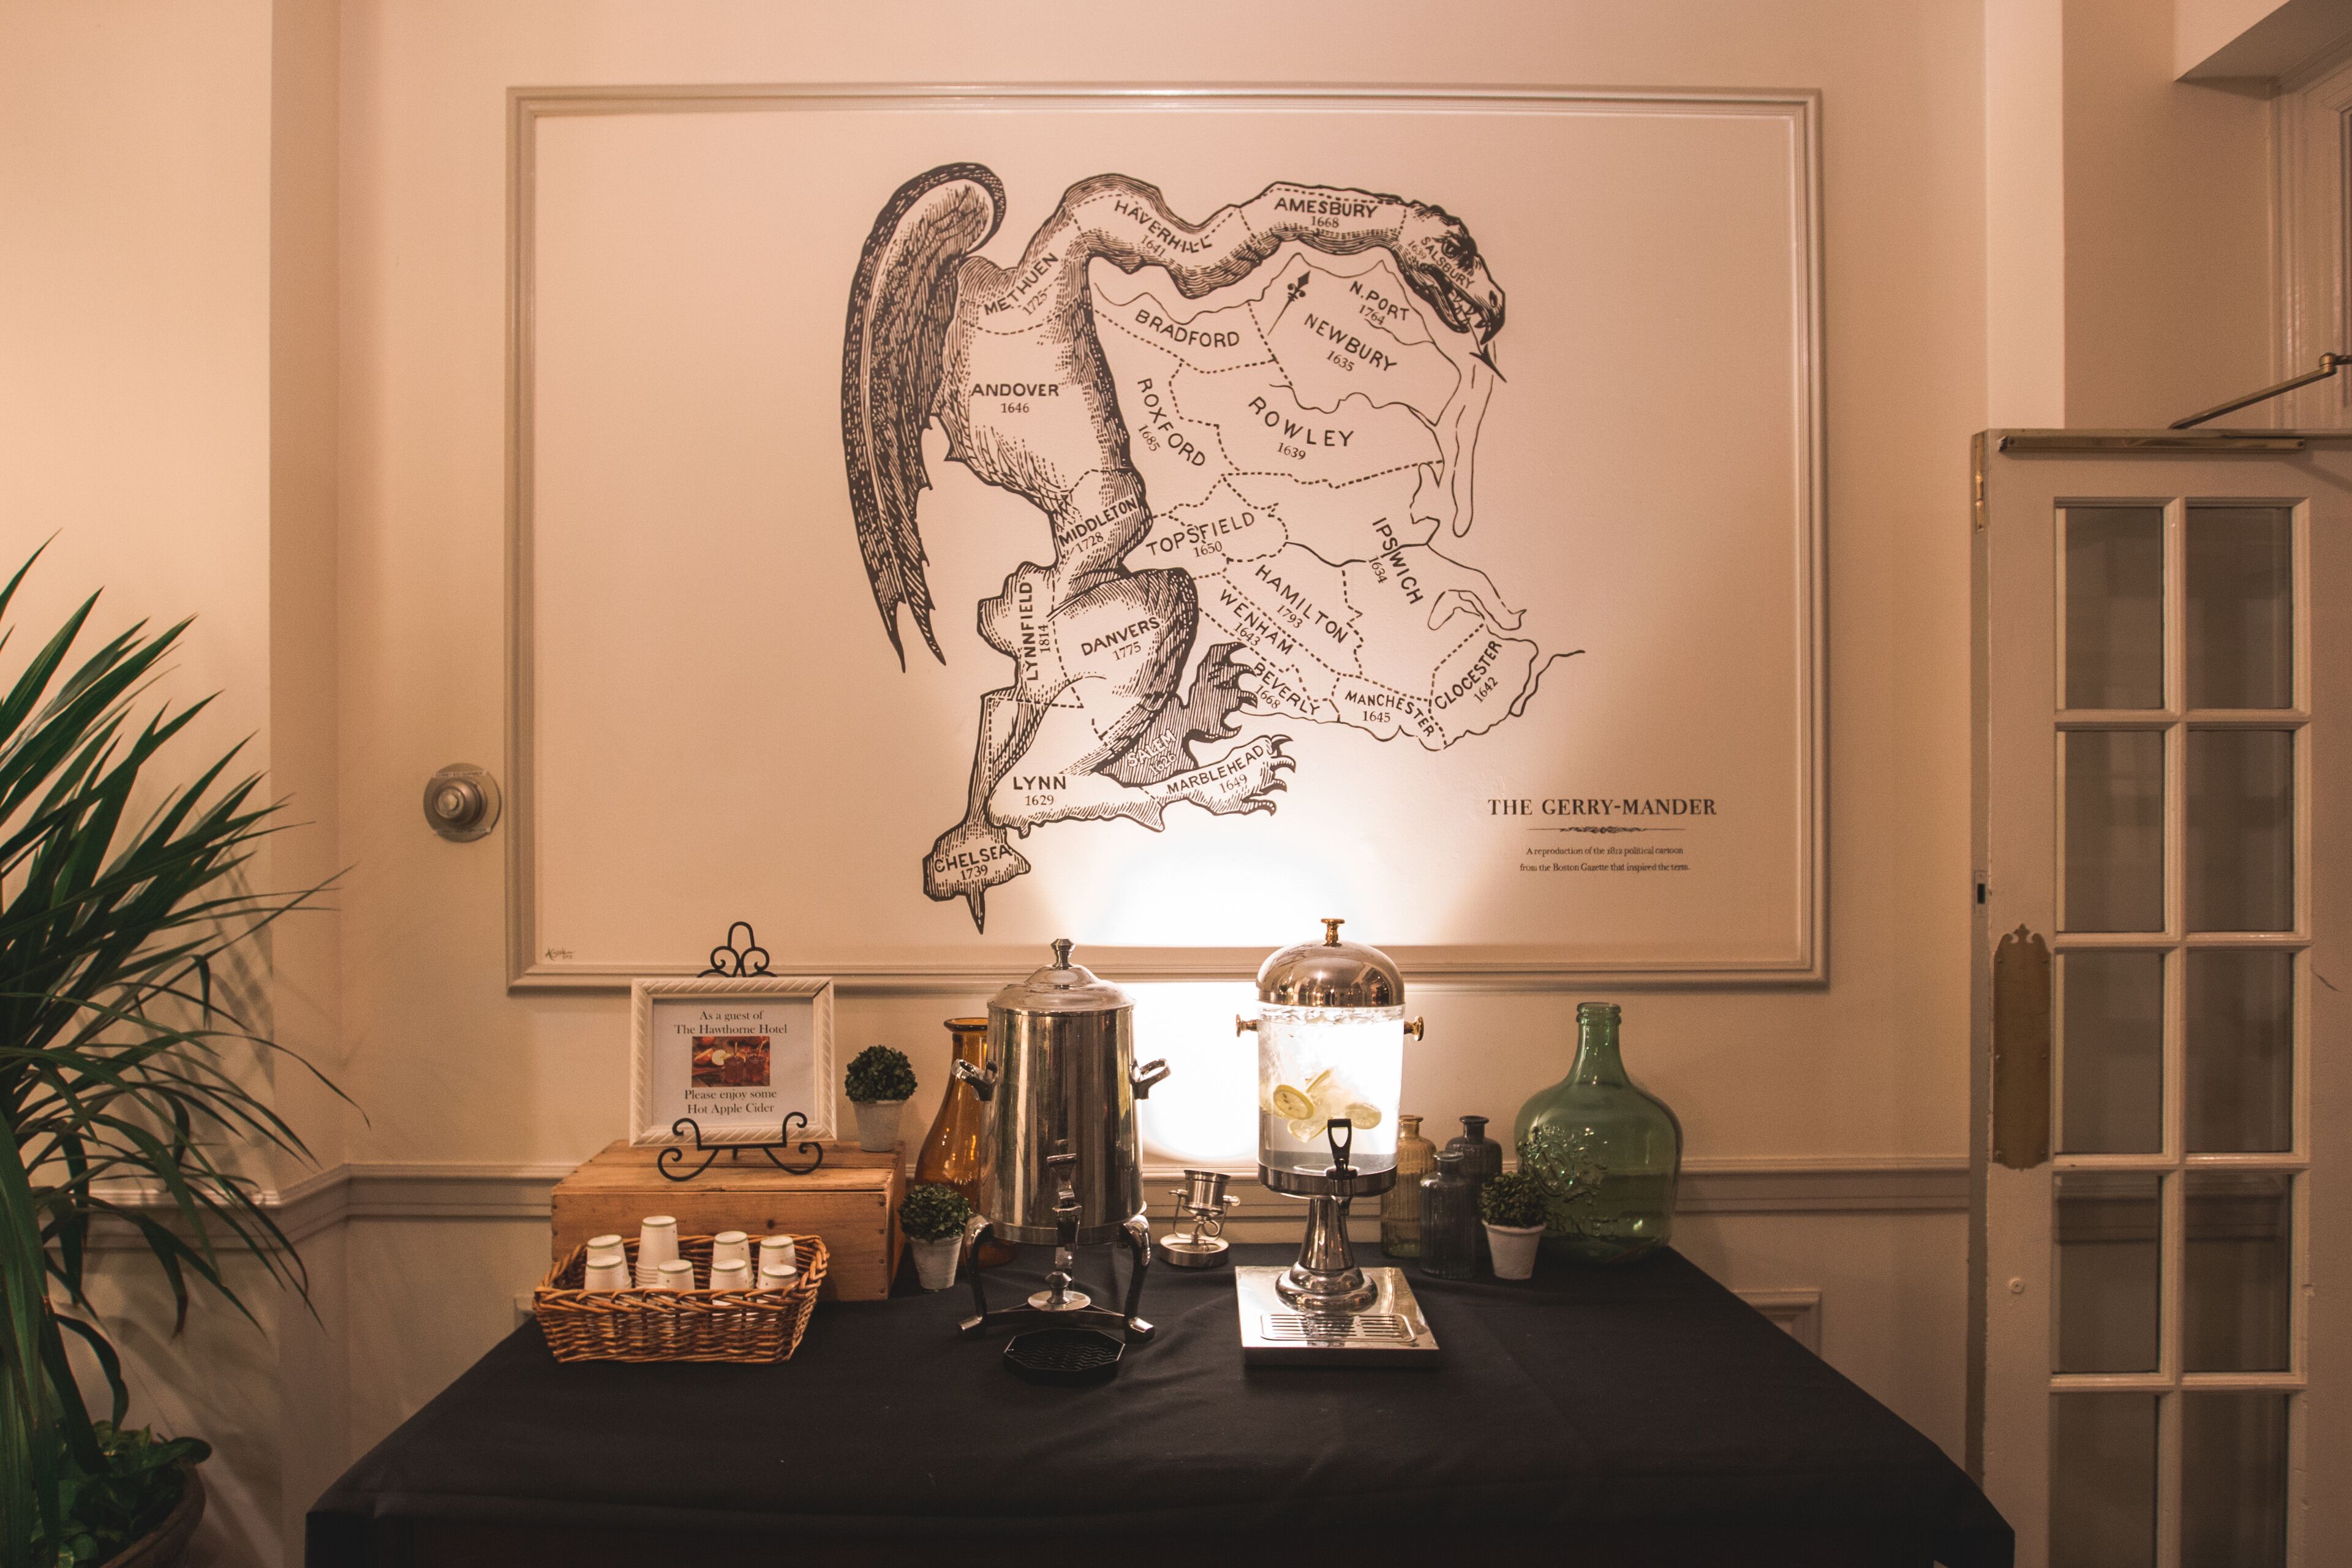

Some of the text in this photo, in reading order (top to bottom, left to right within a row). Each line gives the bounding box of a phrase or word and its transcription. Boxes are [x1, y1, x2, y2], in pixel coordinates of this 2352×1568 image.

[1274, 197, 1378, 219] AMESBURY
[1114, 200, 1213, 253] HAVERHILL
[1311, 216, 1340, 228] 1668
[1140, 234, 1167, 259] 1641
[1408, 240, 1427, 260] 1639
[1421, 236, 1474, 289] SALSBURY
[983, 252, 1059, 315] METHUEN
[1022, 291, 1048, 316] 1725
[1359, 304, 1385, 325] 1764
[1135, 309, 1240, 347] BRADFORD
[1305, 314, 1397, 371] NEWBURY
[1326, 350, 1355, 372] 1635
[971, 383, 1060, 397] ANDOVER
[1000, 402, 1030, 414] 1646
[1248, 396, 1354, 447] ROWLEY
[1138, 423, 1161, 452] 1685
[1276, 442, 1306, 459] 1639
[1058, 498, 1138, 547] MIDDLETON
[1146, 512, 1255, 556] TOPSFIELD
[1074, 532, 1104, 553] 1728
[1193, 541, 1223, 558] 1650
[1368, 555, 1389, 583] 1634
[1373, 517, 1424, 604] IPSWICH
[1255, 565, 1349, 643] HAMILTON
[1276, 604, 1303, 628] 1793
[1019, 582, 1039, 680] LYNNFIELD
[1219, 589, 1294, 655] WENHAM
[1233, 622, 1261, 646] 1643
[1039, 624, 1051, 653] 1814
[1081, 617, 1160, 655] DANVERS
[1113, 642, 1142, 661] 1775
[1253, 662, 1320, 715] BEVERLY
[1254, 685, 1281, 709] 1668
[1473, 677, 1499, 703] 1642
[1345, 690, 1434, 737] MANCHESTER
[1362, 710, 1391, 723] 1645
[1127, 728, 1177, 767] SALEM
[1148, 752, 1177, 776] 1626
[1167, 745, 1264, 794] MARBLEHEAD
[1013, 776, 1066, 790] LYNN
[1219, 774, 1247, 793] 1649
[1025, 795, 1054, 806] 1629
[1488, 799, 1717, 815] THE GERRY-MANDER
[935, 845, 1012, 872] CHELSEA
[1534, 848, 1583, 856] reproduction
[1624, 846, 1654, 856] political
[960, 865, 989, 881] 1739
[1627, 864, 1657, 872] inspired
[700, 1011, 712, 1020] As
[725, 1012, 750, 1021] guest
[753, 1011, 764, 1020] of
[674, 1024, 787, 1034] The Hawthorne Hotel
[685, 1090, 716, 1099] Please
[720, 1090, 747, 1101] enjoy
[687, 1103, 774, 1115] Hot Apple Cider
